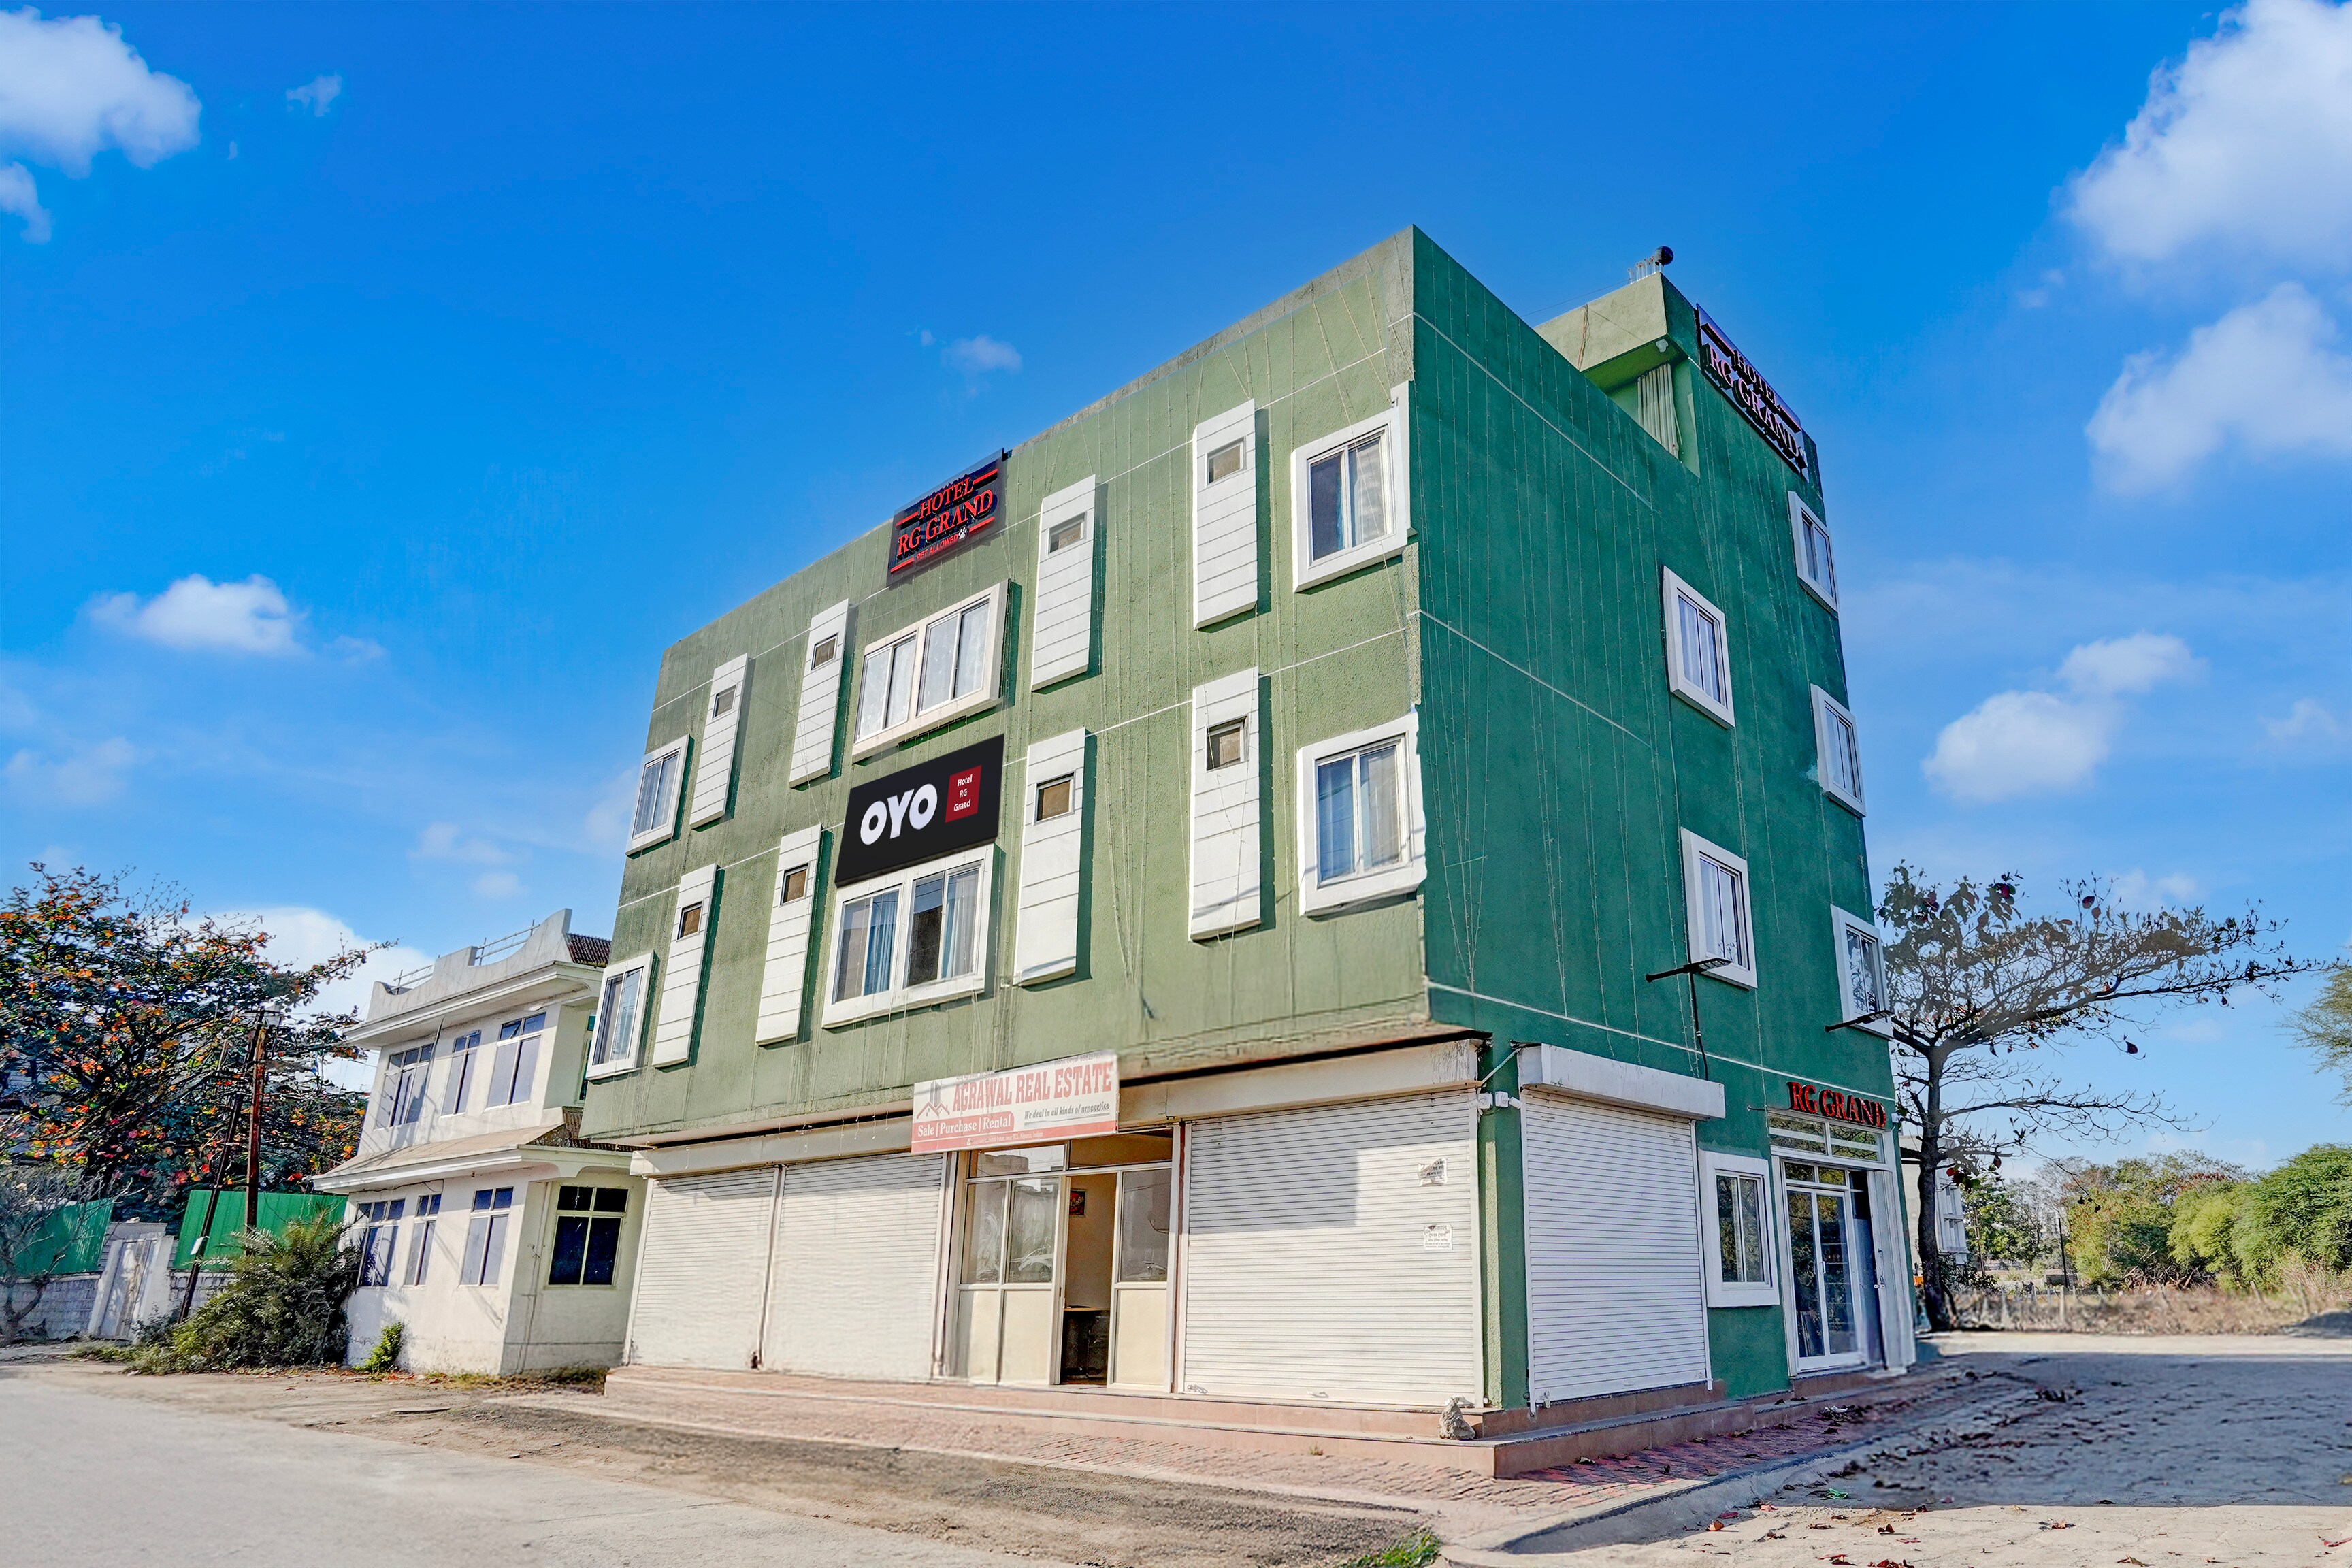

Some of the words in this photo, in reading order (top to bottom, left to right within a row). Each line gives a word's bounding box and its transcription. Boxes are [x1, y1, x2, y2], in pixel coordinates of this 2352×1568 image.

[1706, 343, 1734, 388] RG
[1737, 376, 1799, 457] GRAND
[1737, 351, 1781, 408] HOTEL
[919, 476, 975, 520] HOTEL
[896, 526, 921, 557] RG
[925, 489, 993, 540] GRAND
[915, 549, 928, 561] PET
[928, 533, 959, 554] ALLOWED
[957, 774, 973, 787] Hotel
[959, 788, 968, 798] RG
[860, 783, 938, 845] OYO
[953, 798, 971, 812] Grand
[952, 1077, 1013, 1112] AGRAWAL
[1015, 1071, 1051, 1104] REAL
[1054, 1061, 1113, 1098] ESTATE
[1788, 1081, 1818, 1114] RG
[1819, 1089, 1886, 1128] GRAND
[917, 1123, 935, 1137] Sale
[939, 1120, 977, 1135] Purchase
[983, 1114, 1011, 1130] Rental
[1024, 1110, 1032, 1120] We
[1032, 1109, 1044, 1119] deal
[1045, 1108, 1050, 1117] in
[1059, 1105, 1074, 1115] kinds
[1075, 1103, 1081, 1114] of
